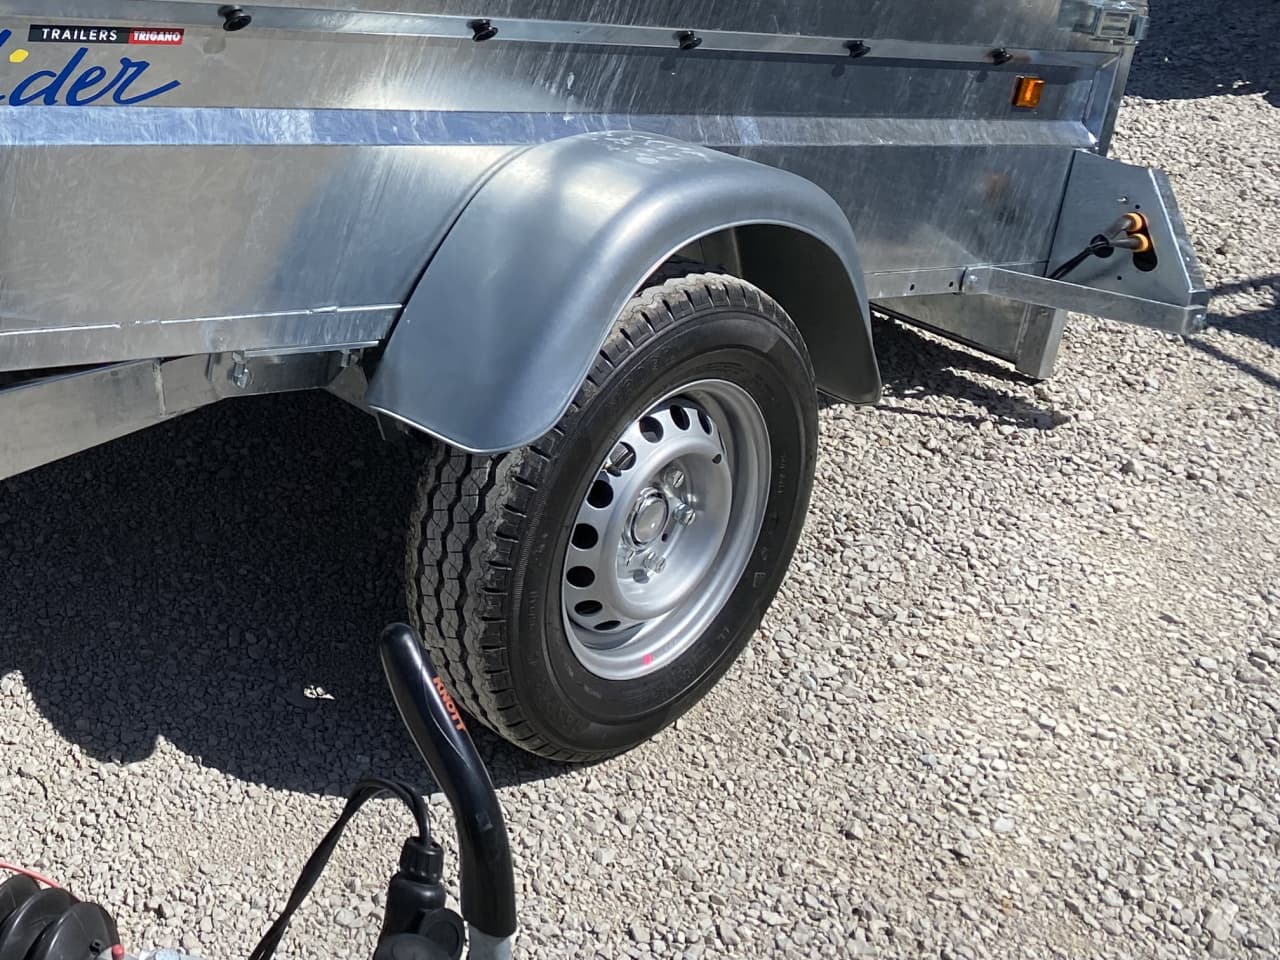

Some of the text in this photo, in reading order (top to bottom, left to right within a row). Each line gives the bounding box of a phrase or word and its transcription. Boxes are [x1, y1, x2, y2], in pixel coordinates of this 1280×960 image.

[41, 27, 181, 43] TRAILERS TRIGANO
[432, 675, 467, 731] KNOTT
